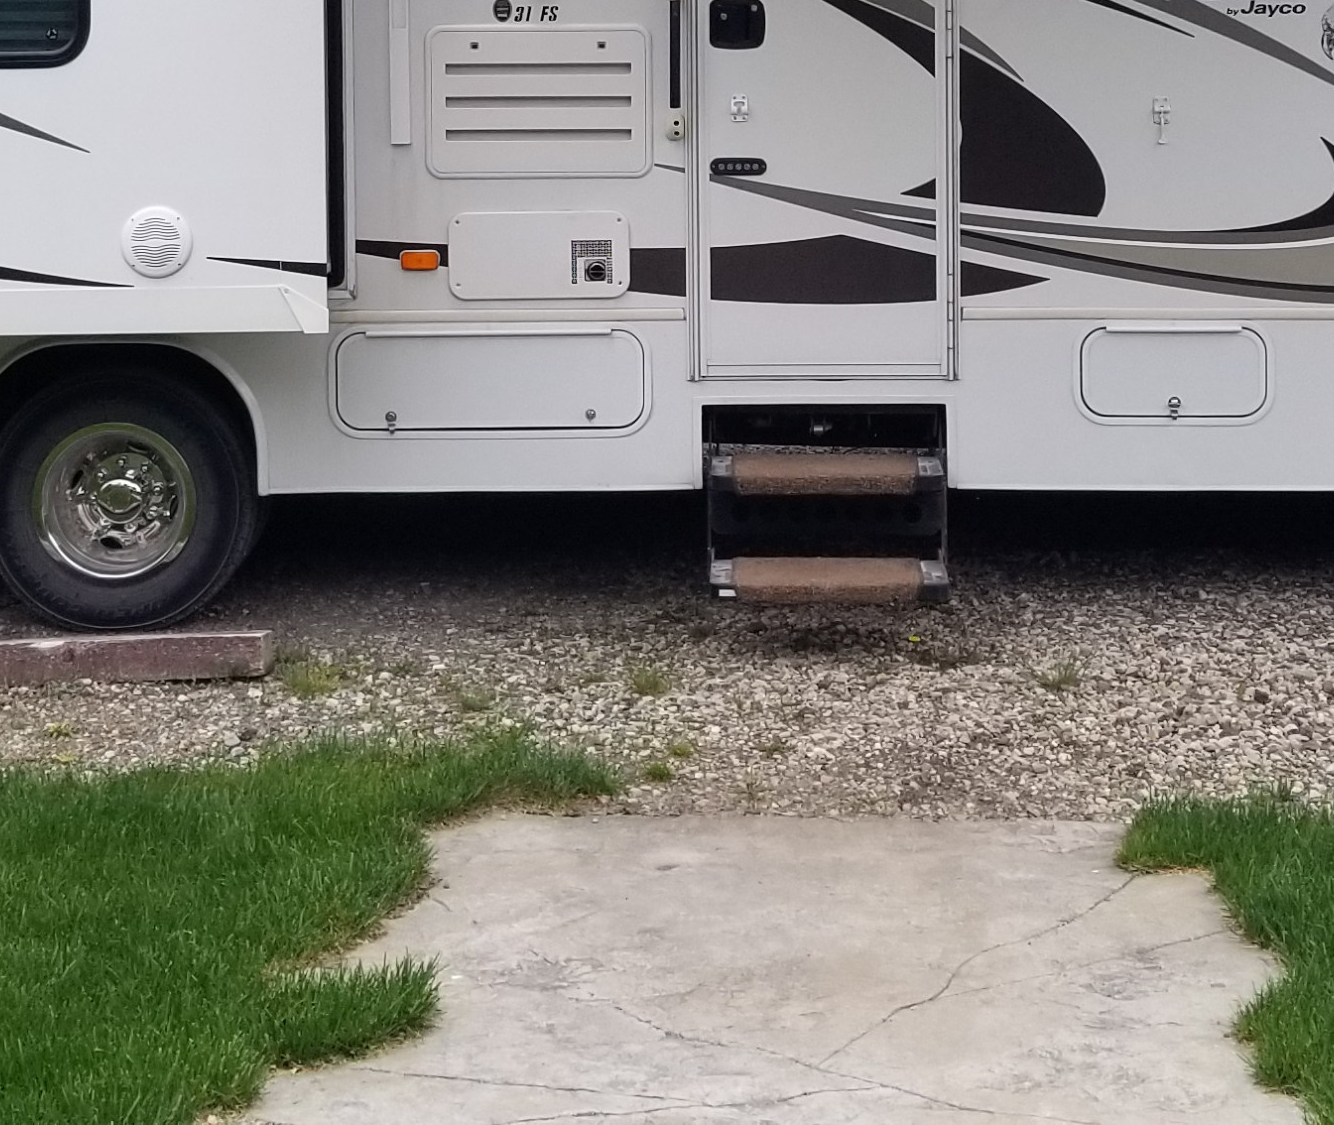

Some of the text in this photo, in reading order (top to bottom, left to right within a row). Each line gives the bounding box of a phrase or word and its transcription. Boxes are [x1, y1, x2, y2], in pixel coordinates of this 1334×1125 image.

[514, 6, 559, 22] 31 FS
[1227, 0, 1306, 17] by Jayco
